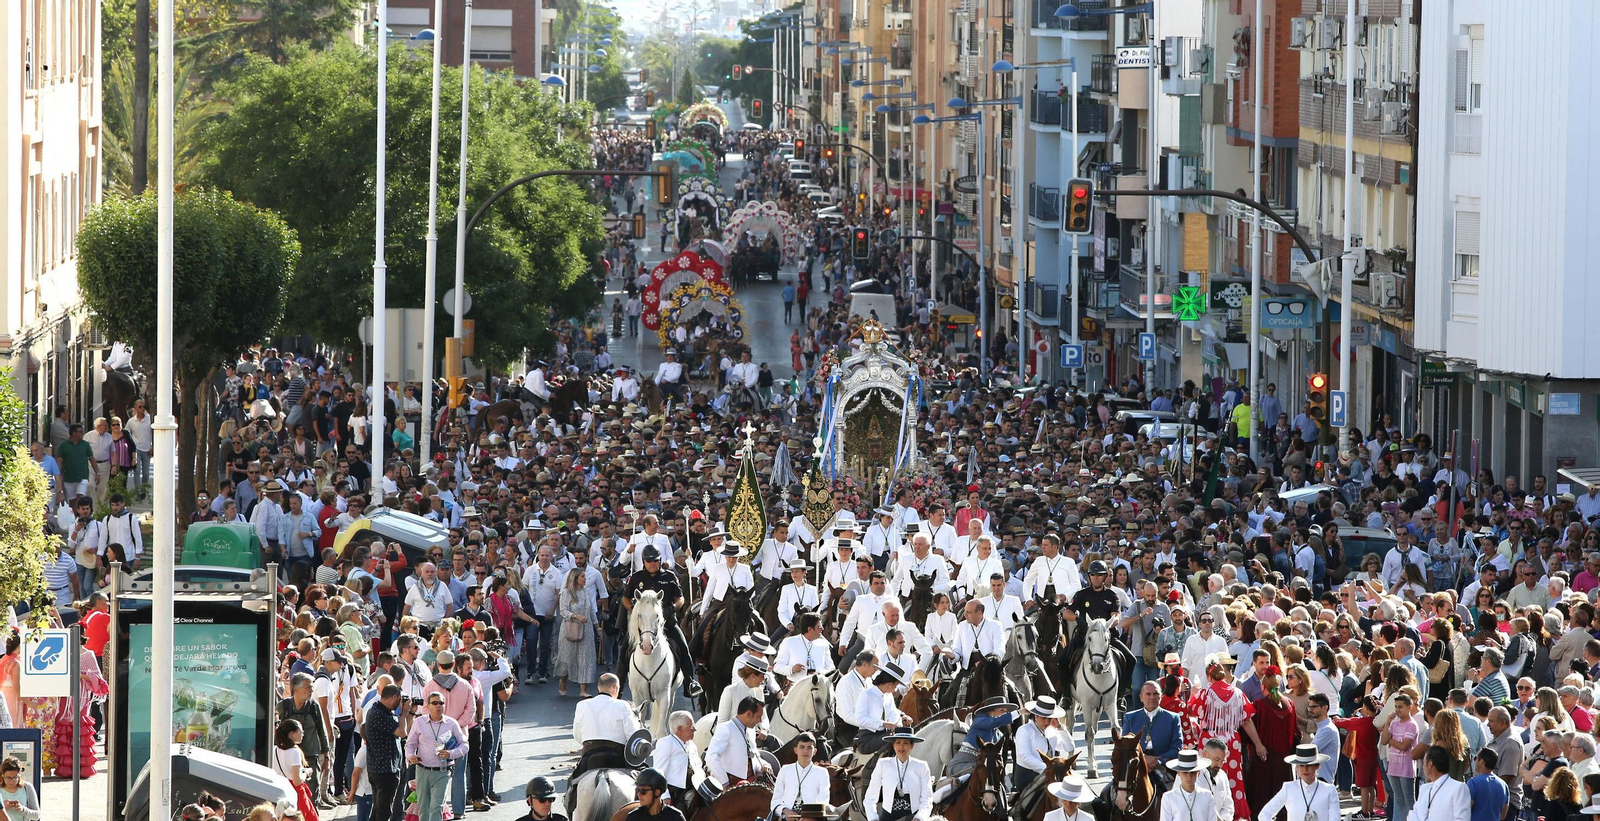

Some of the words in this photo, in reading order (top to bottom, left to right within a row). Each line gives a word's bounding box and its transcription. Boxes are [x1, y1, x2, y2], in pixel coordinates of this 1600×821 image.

[1142, 336, 1152, 357] P
[1065, 347, 1079, 365] P
[1333, 394, 1343, 422] P
[174, 651, 205, 660] DEJARÁ
[201, 643, 228, 651] SABOR
